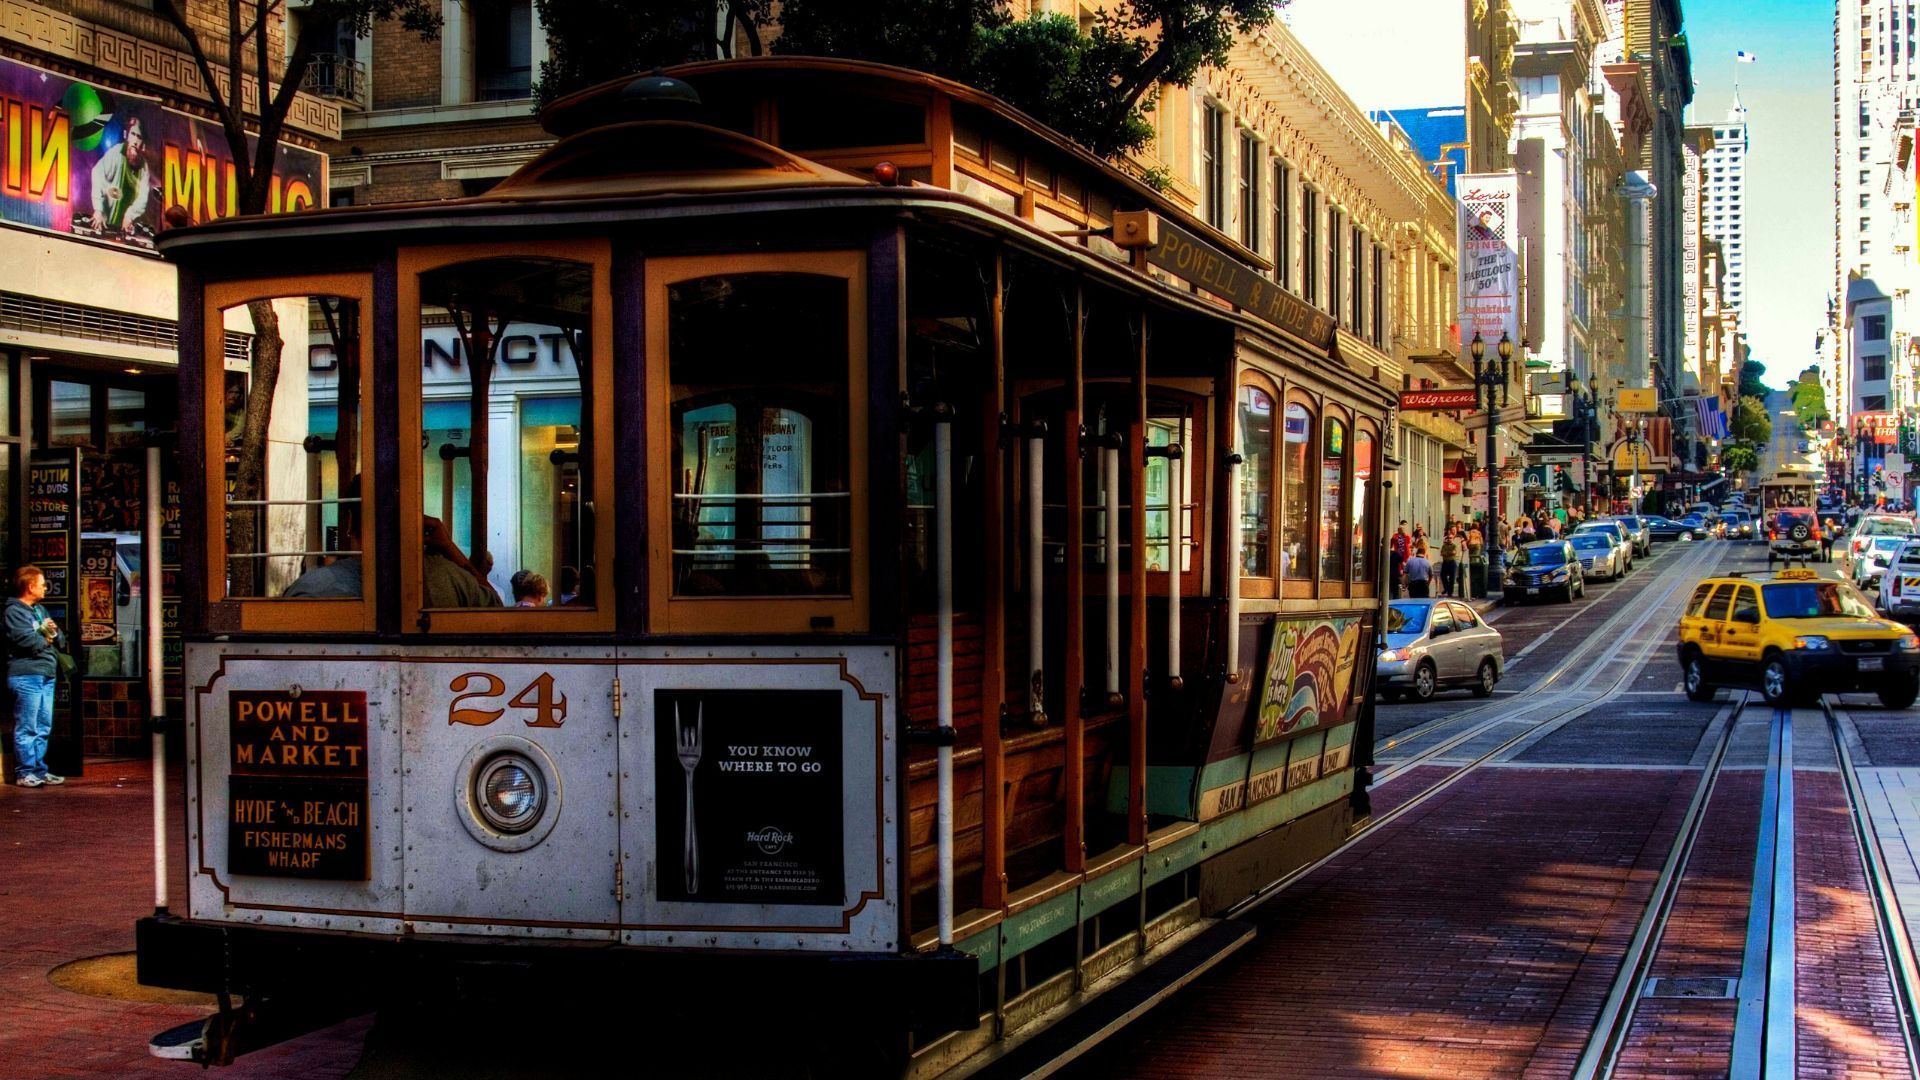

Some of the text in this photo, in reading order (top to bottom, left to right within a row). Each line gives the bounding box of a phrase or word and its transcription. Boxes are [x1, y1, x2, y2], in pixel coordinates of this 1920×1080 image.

[1478, 253, 1497, 267] THE
[1158, 230, 1238, 296] POWELL
[1251, 281, 1263, 309] &
[1269, 291, 1308, 331] HYDE
[1464, 262, 1511, 282] FABULOUS
[1684, 282, 1697, 345] HOTEL
[1403, 394, 1477, 406] Walgreens
[711, 425, 730, 436] FARE
[1782, 570, 1815, 578] YELLOW
[448, 671, 568, 728] 24
[238, 701, 360, 723] POWELL
[270, 726, 329, 742] AND
[236, 744, 362, 766] MARKET
[728, 745, 812, 758] YOU KNOW
[718, 760, 822, 773] WHERE TO GO
[1218, 786, 1237, 812] SAN
[235, 800, 359, 826] HYDE AND BEACH
[245, 831, 347, 850] FISHERMANS
[747, 832, 794, 844] Hard Rock
[268, 851, 321, 869] WHARF
